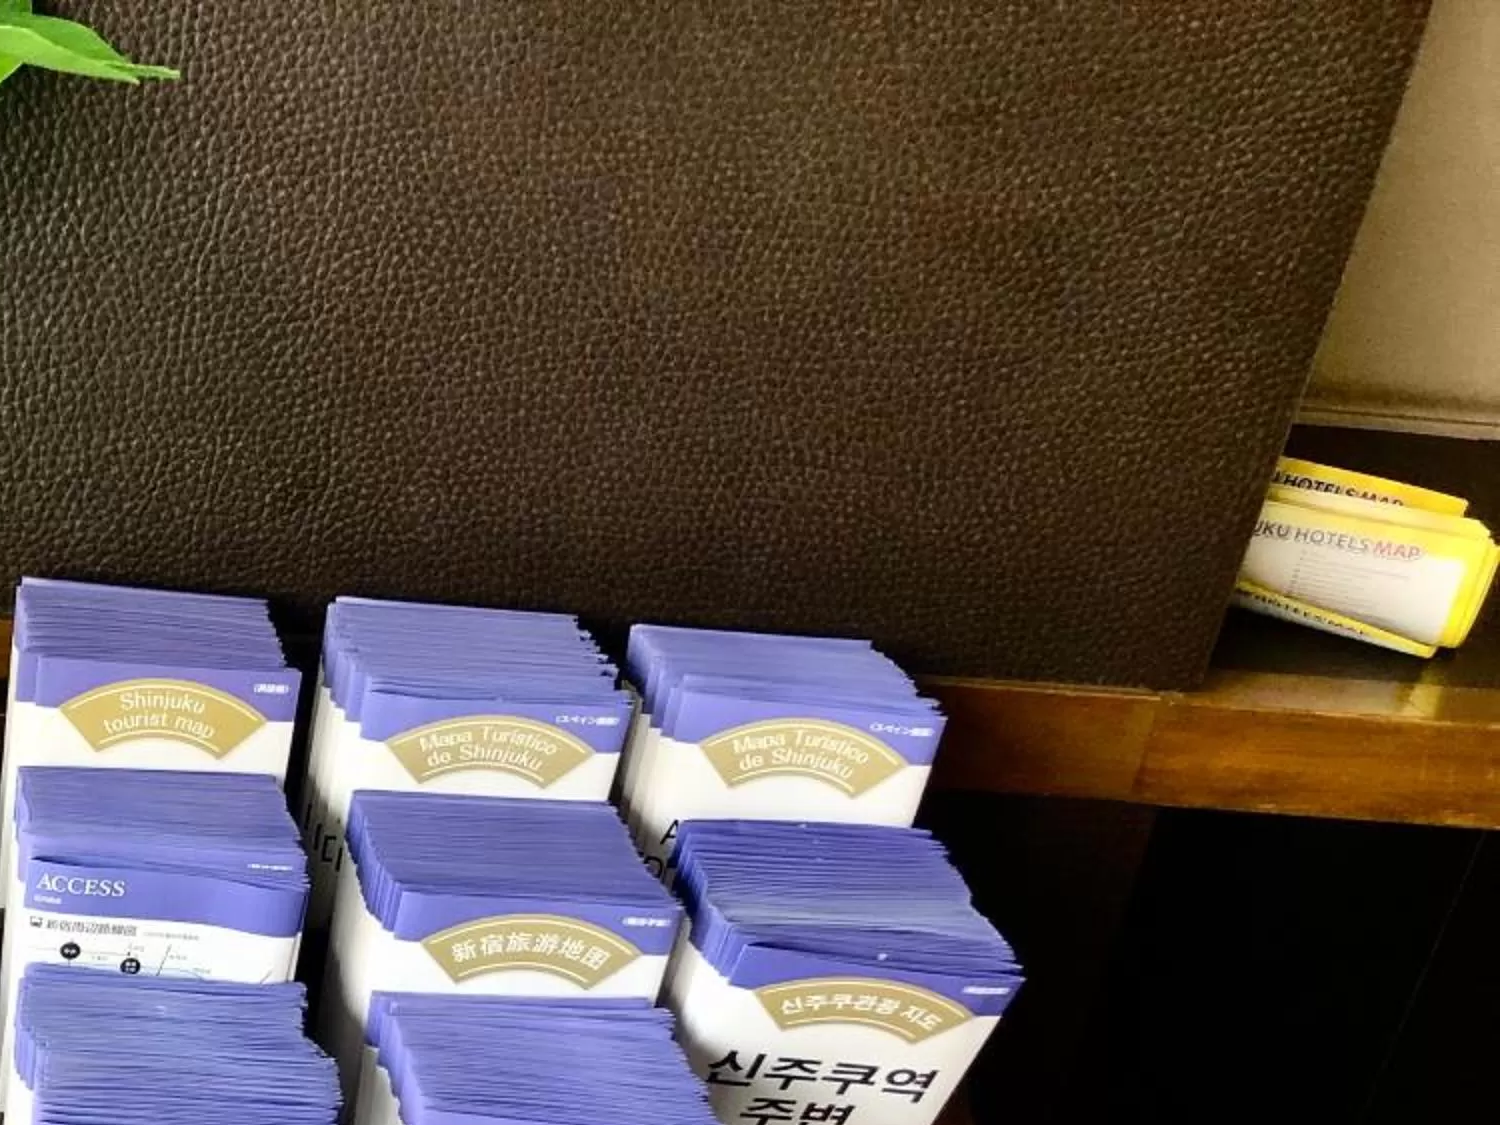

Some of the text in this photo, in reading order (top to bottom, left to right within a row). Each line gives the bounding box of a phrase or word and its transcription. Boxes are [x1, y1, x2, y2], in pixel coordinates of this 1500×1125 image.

[1293, 526, 1370, 551] HOTELS
[1372, 540, 1422, 561] MAP
[119, 690, 205, 715] Shinjuku
[103, 711, 215, 739] tourist map
[459, 743, 543, 773] Shinjuku
[739, 747, 853, 779] de Shinjuku
[36, 872, 126, 897] ACCESS
[705, 1049, 939, 1104] 신주쿠역
